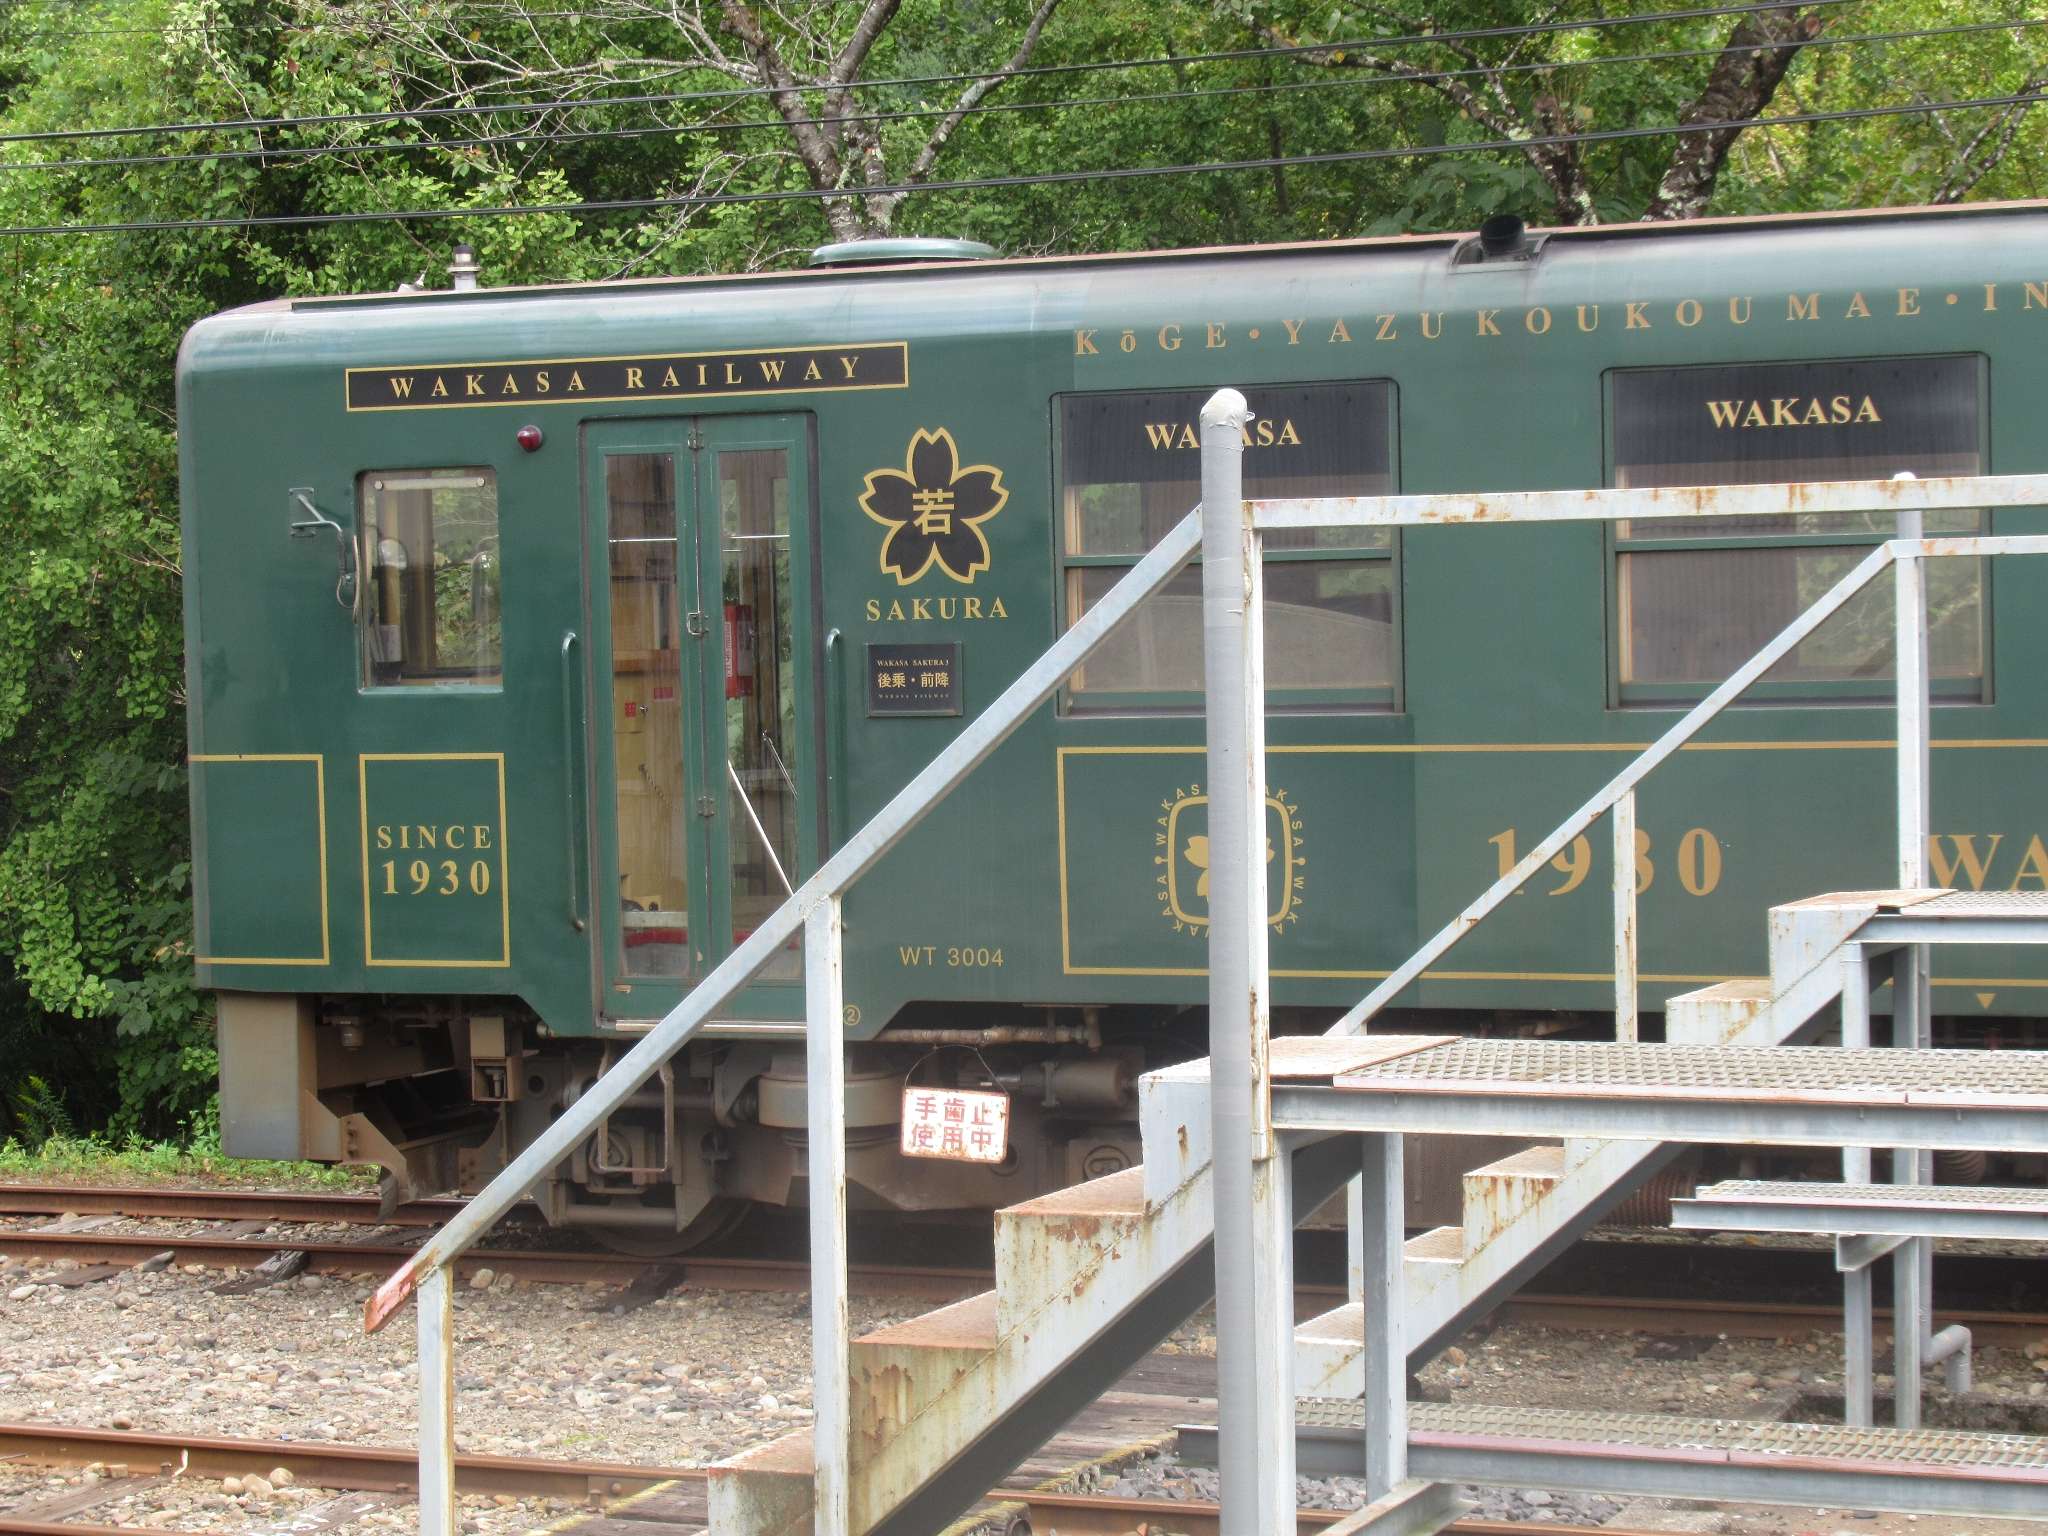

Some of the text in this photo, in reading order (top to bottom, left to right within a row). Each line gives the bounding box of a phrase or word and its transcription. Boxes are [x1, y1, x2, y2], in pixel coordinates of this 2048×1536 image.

[389, 355, 860, 399] WAKASA RAILWAY
[1706, 395, 1882, 429] WAKASA
[912, 488, 955, 536] 若
[866, 596, 1009, 622] SAKURA
[377, 824, 492, 850] SINCE
[382, 859, 491, 896] 1930
[899, 946, 1004, 967] WT 3004
[911, 1123, 993, 1153] 使用中
